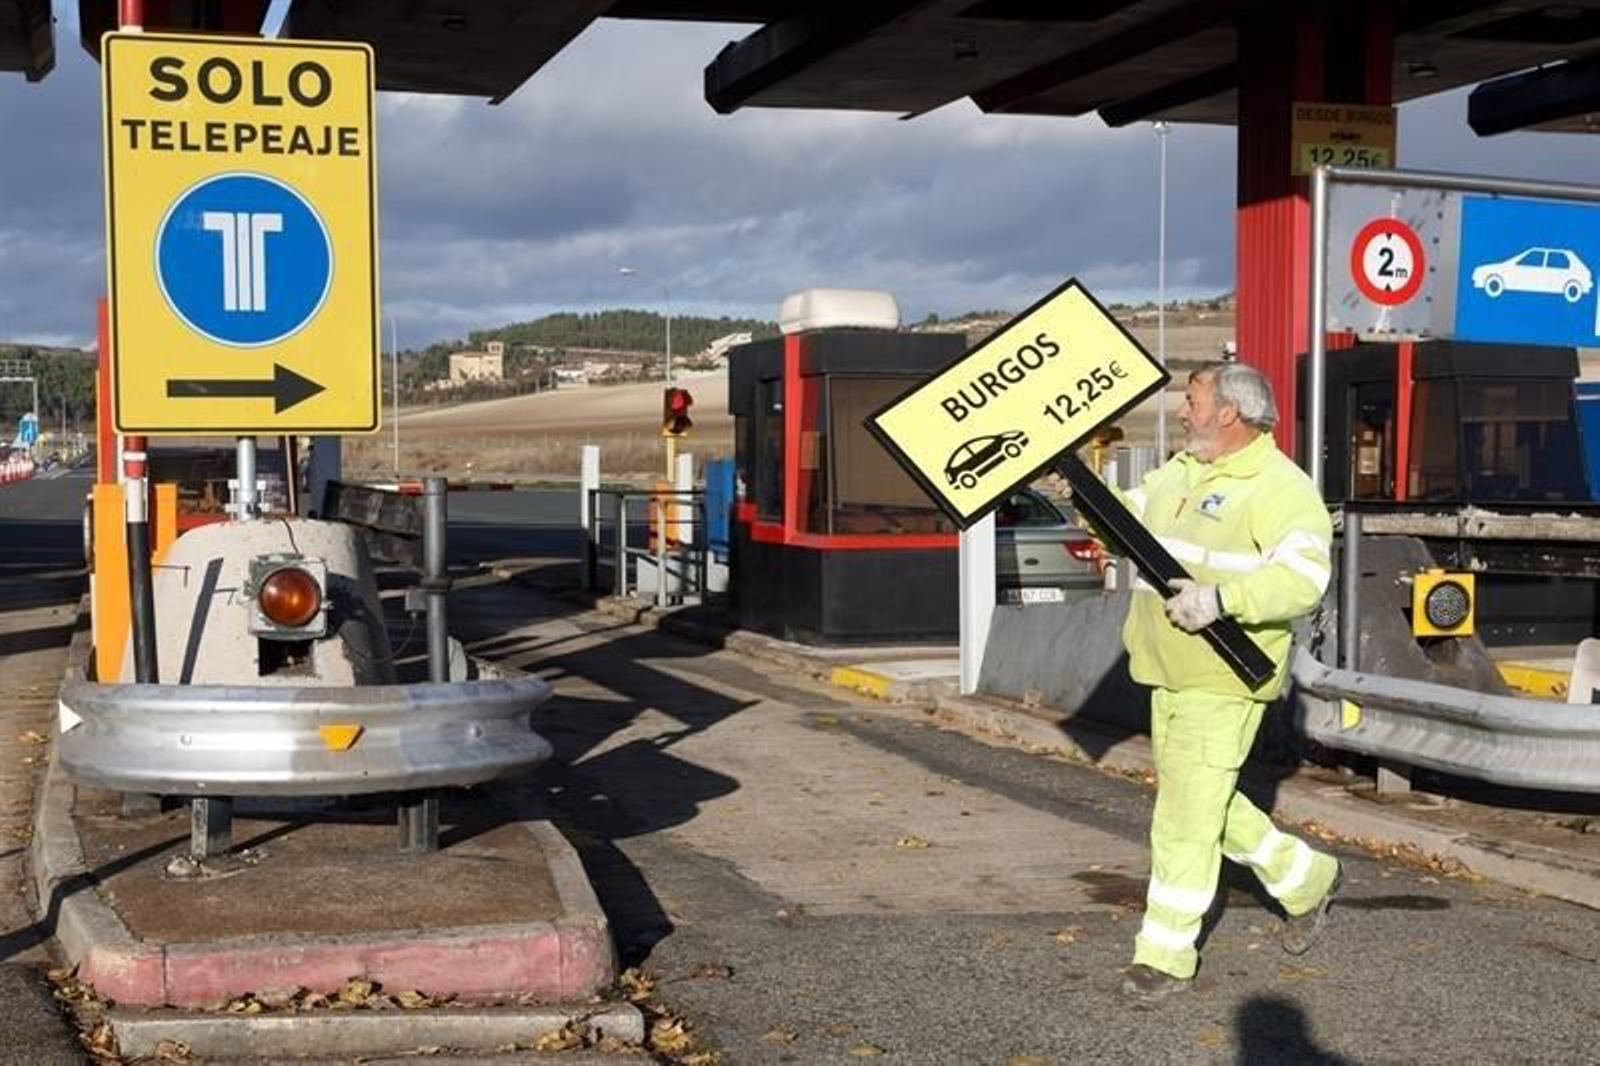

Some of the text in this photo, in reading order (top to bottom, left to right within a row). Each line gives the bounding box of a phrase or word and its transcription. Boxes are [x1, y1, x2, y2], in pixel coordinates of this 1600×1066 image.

[149, 56, 332, 107] SOLO
[121, 119, 360, 157] TELEPEAJE
[1310, 147, 1382, 167] 1225€
[941, 333, 1060, 422] BURGOS
[1043, 360, 1129, 426] 12,25€
